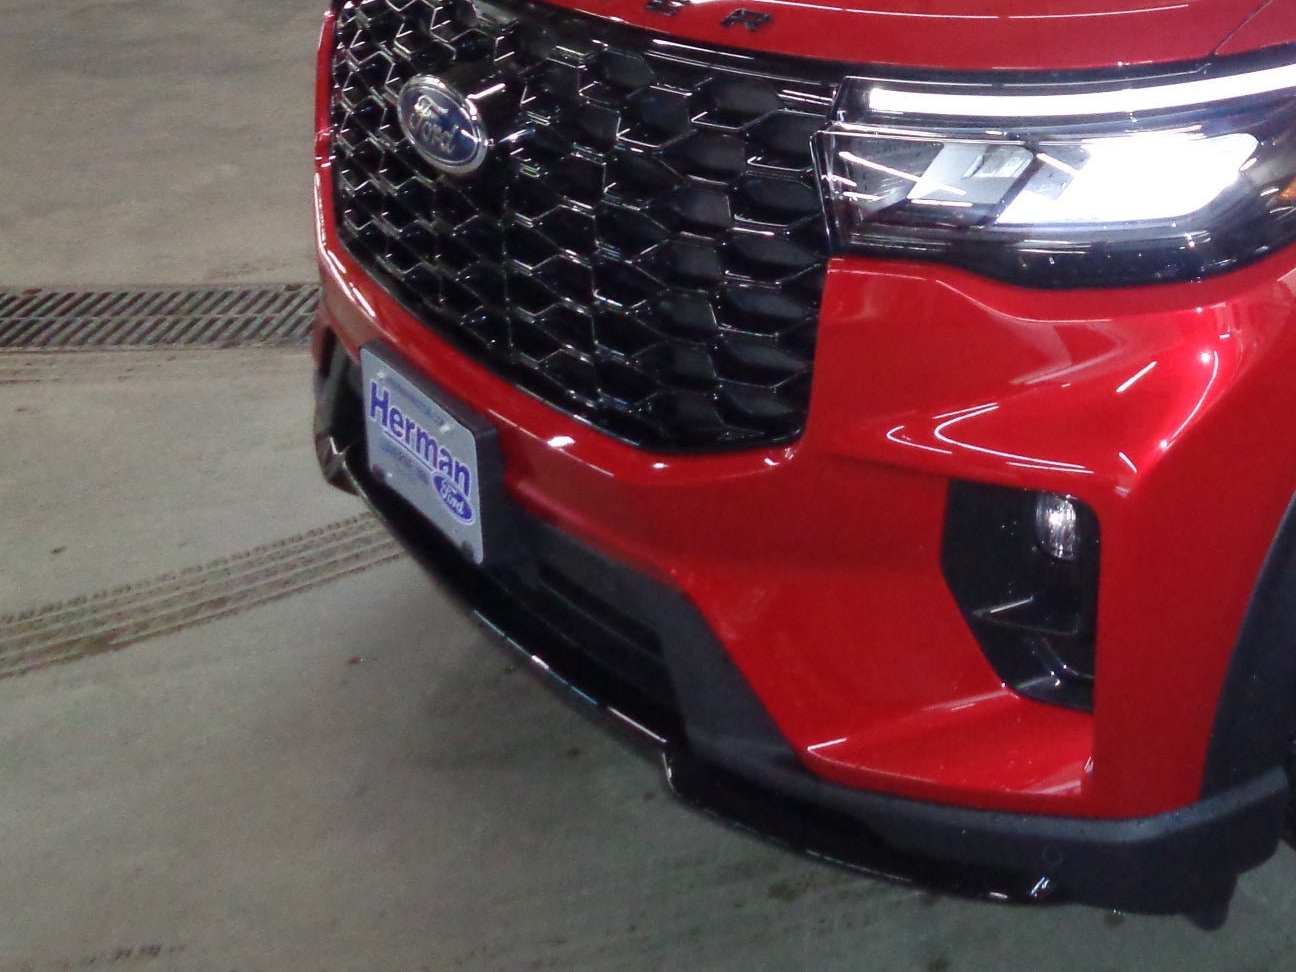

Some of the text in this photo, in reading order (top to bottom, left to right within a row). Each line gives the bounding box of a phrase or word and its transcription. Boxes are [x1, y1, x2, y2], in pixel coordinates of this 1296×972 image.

[409, 94, 457, 154] Ford
[369, 381, 471, 498] Herman
[441, 477, 466, 516] Ford
